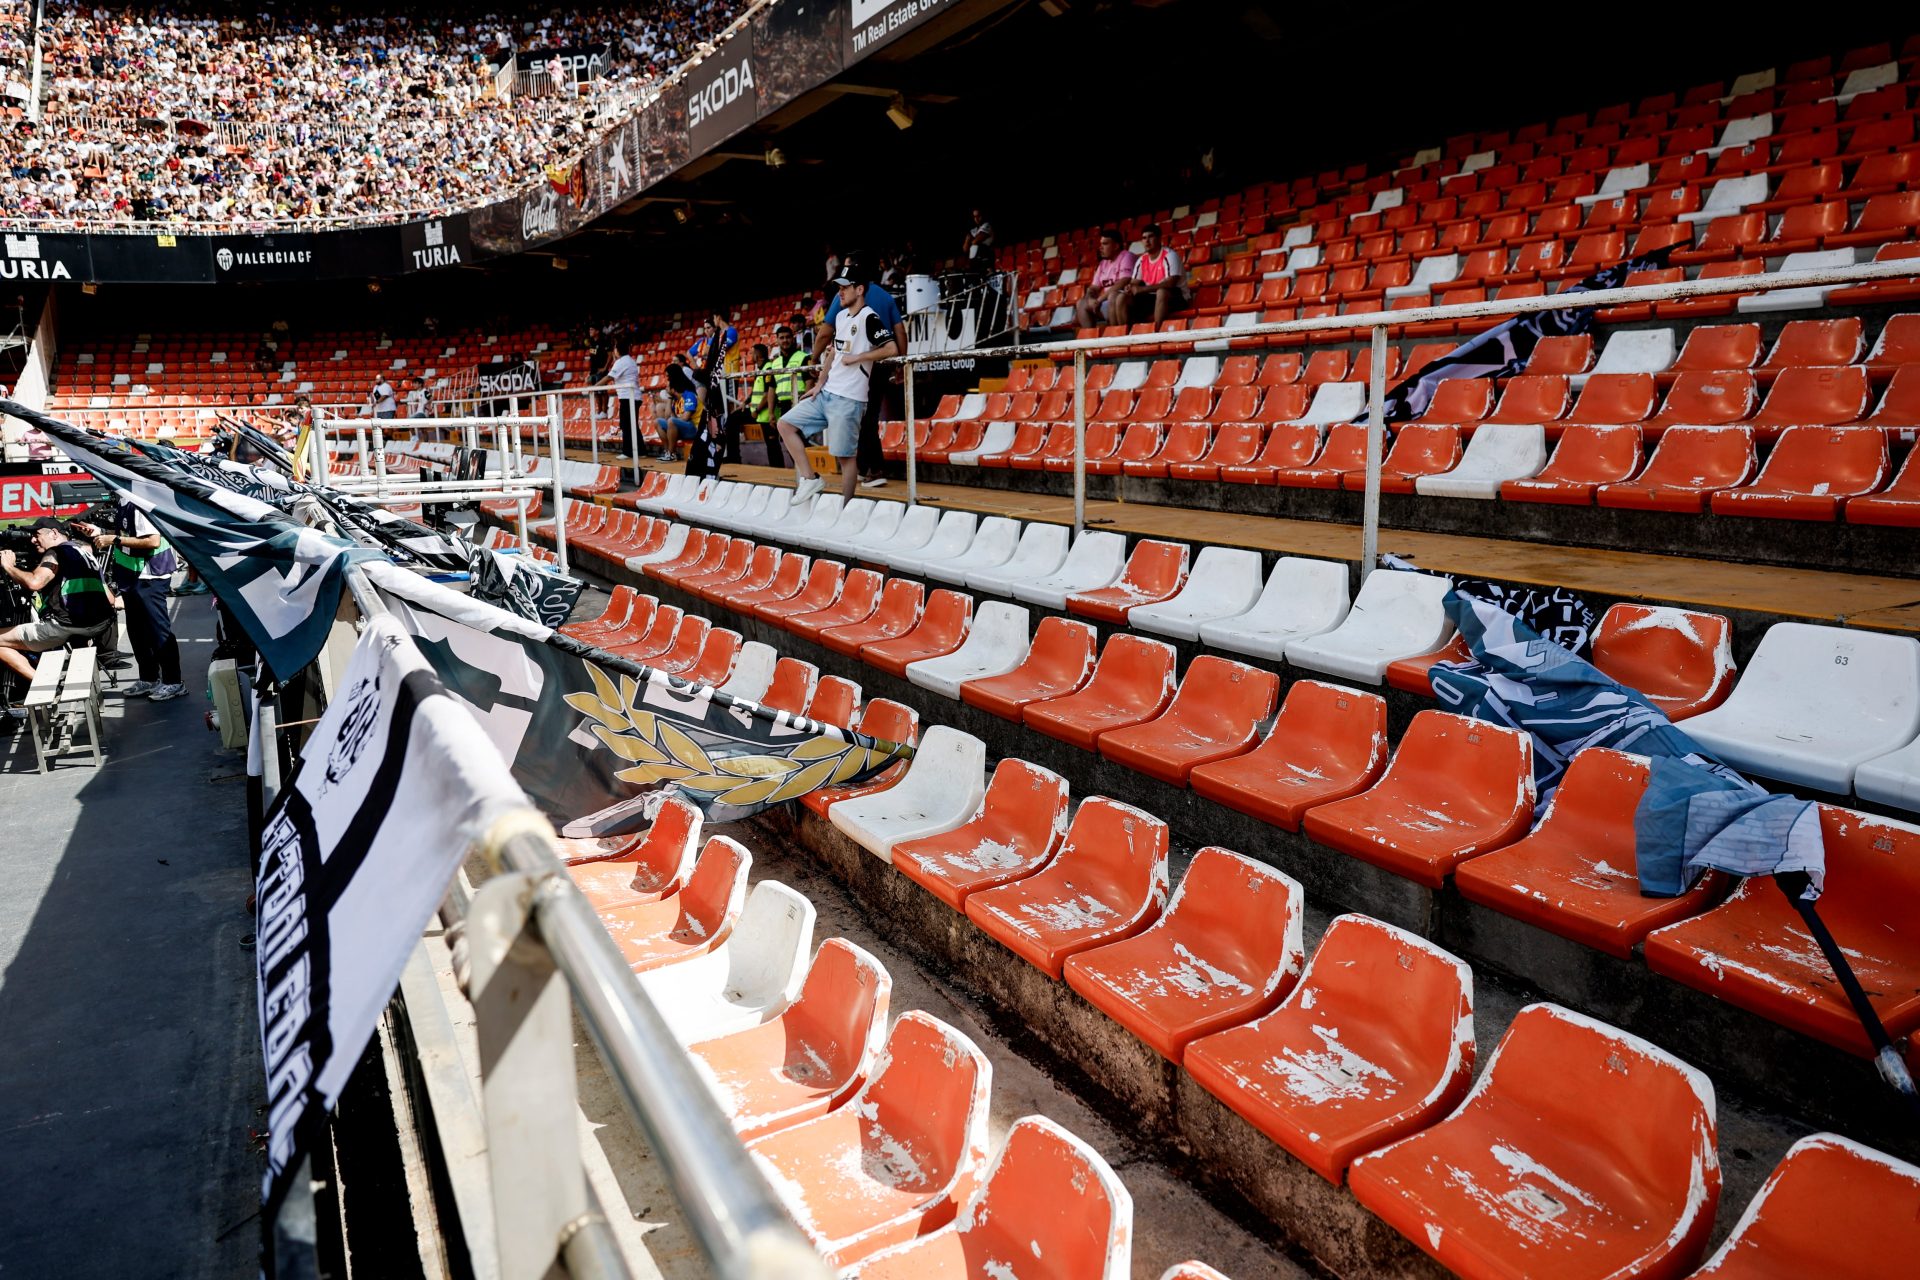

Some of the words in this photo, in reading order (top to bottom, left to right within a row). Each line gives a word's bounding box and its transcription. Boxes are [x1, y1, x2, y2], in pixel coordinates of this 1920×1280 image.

[852, 30, 867, 53] TM
[868, 16, 887, 44] Real
[888, 2, 918, 31] Estate
[530, 53, 602, 75] SODA
[688, 58, 754, 128] SKODA
[236, 251, 312, 265] VALENCIACF
[412, 245, 461, 269] TURIA
[951, 359, 976, 372] Group
[1834, 655, 1849, 666] 63
[1874, 839, 1893, 851] 46
